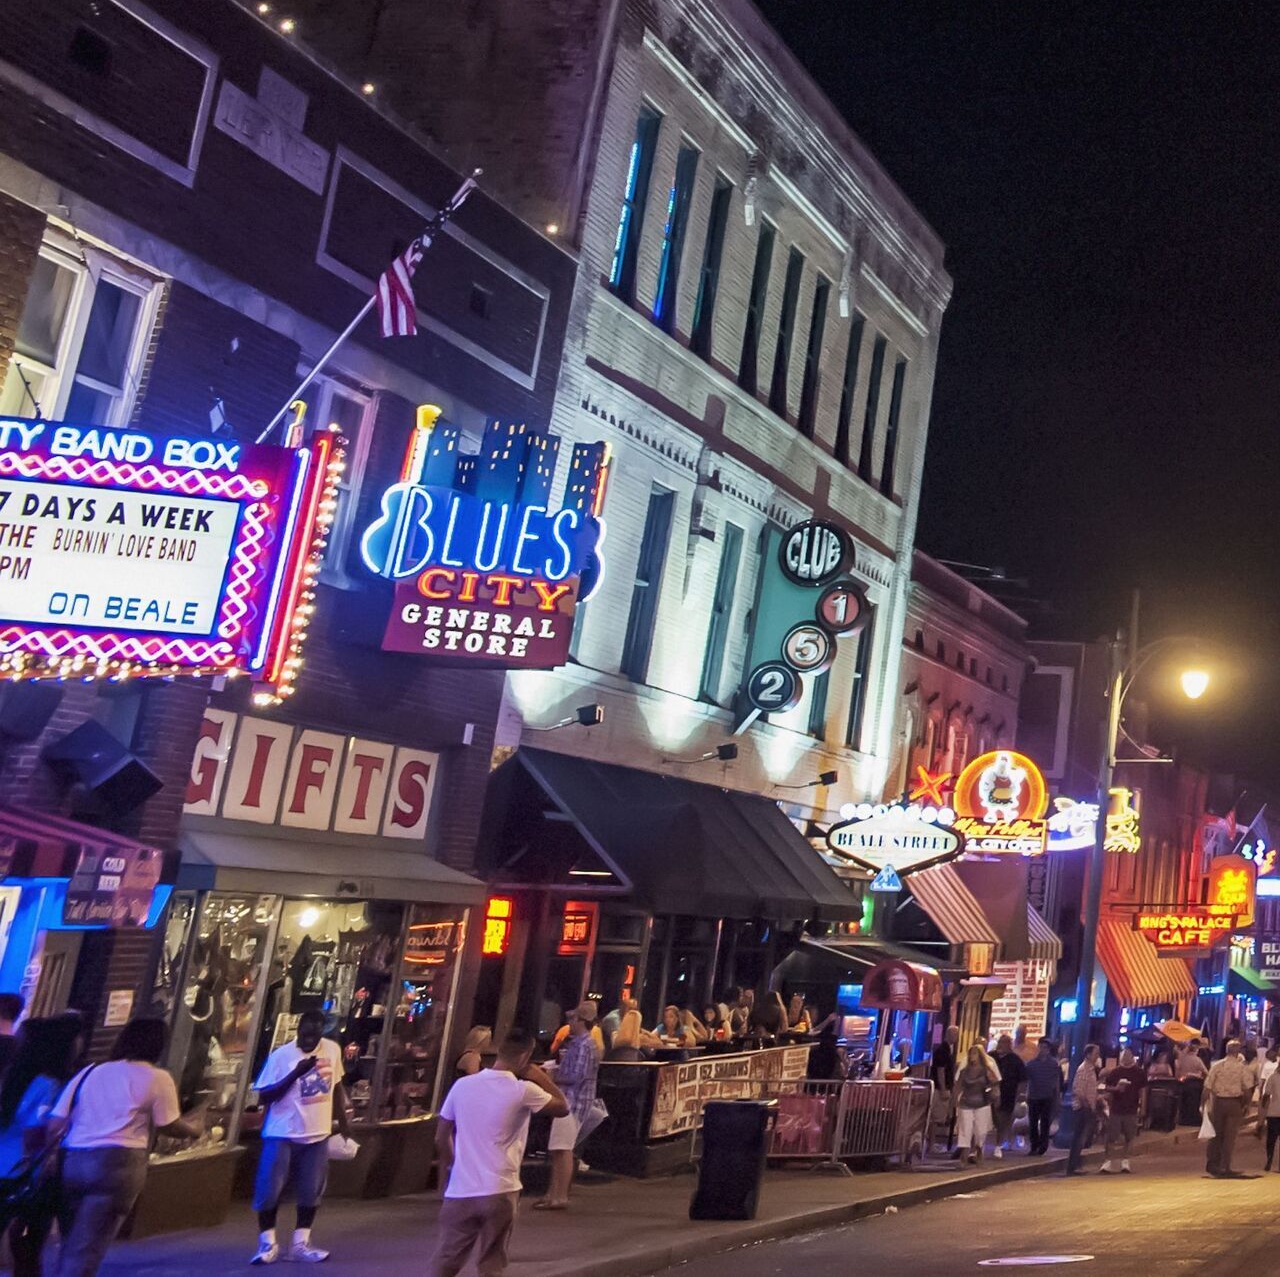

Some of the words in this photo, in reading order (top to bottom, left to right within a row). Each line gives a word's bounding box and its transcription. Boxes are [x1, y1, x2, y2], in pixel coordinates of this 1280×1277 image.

[51, 427, 154, 462] BAND
[163, 439, 241, 472] BOX
[21, 494, 97, 522] DAYS
[107, 502, 125, 525] A
[141, 504, 214, 532] WEEK
[0, 524, 37, 548] THE
[53, 528, 115, 555] BURNIN'
[117, 533, 155, 558] LOVE
[159, 537, 197, 562] BAND
[394, 486, 578, 581] BLUES
[786, 525, 841, 579] CLUB
[0, 556, 31, 580] PM
[417, 568, 570, 611] CITY
[104, 596, 199, 625] BEALE
[402, 603, 556, 639] GENERAL
[423, 628, 529, 657] STORE
[185, 719, 432, 828] GIFTS
[838, 831, 886, 848] BEALE
[892, 834, 952, 850] STREET
[1158, 929, 1211, 945] CAFE
[1178, 916, 1232, 929] PALACE
